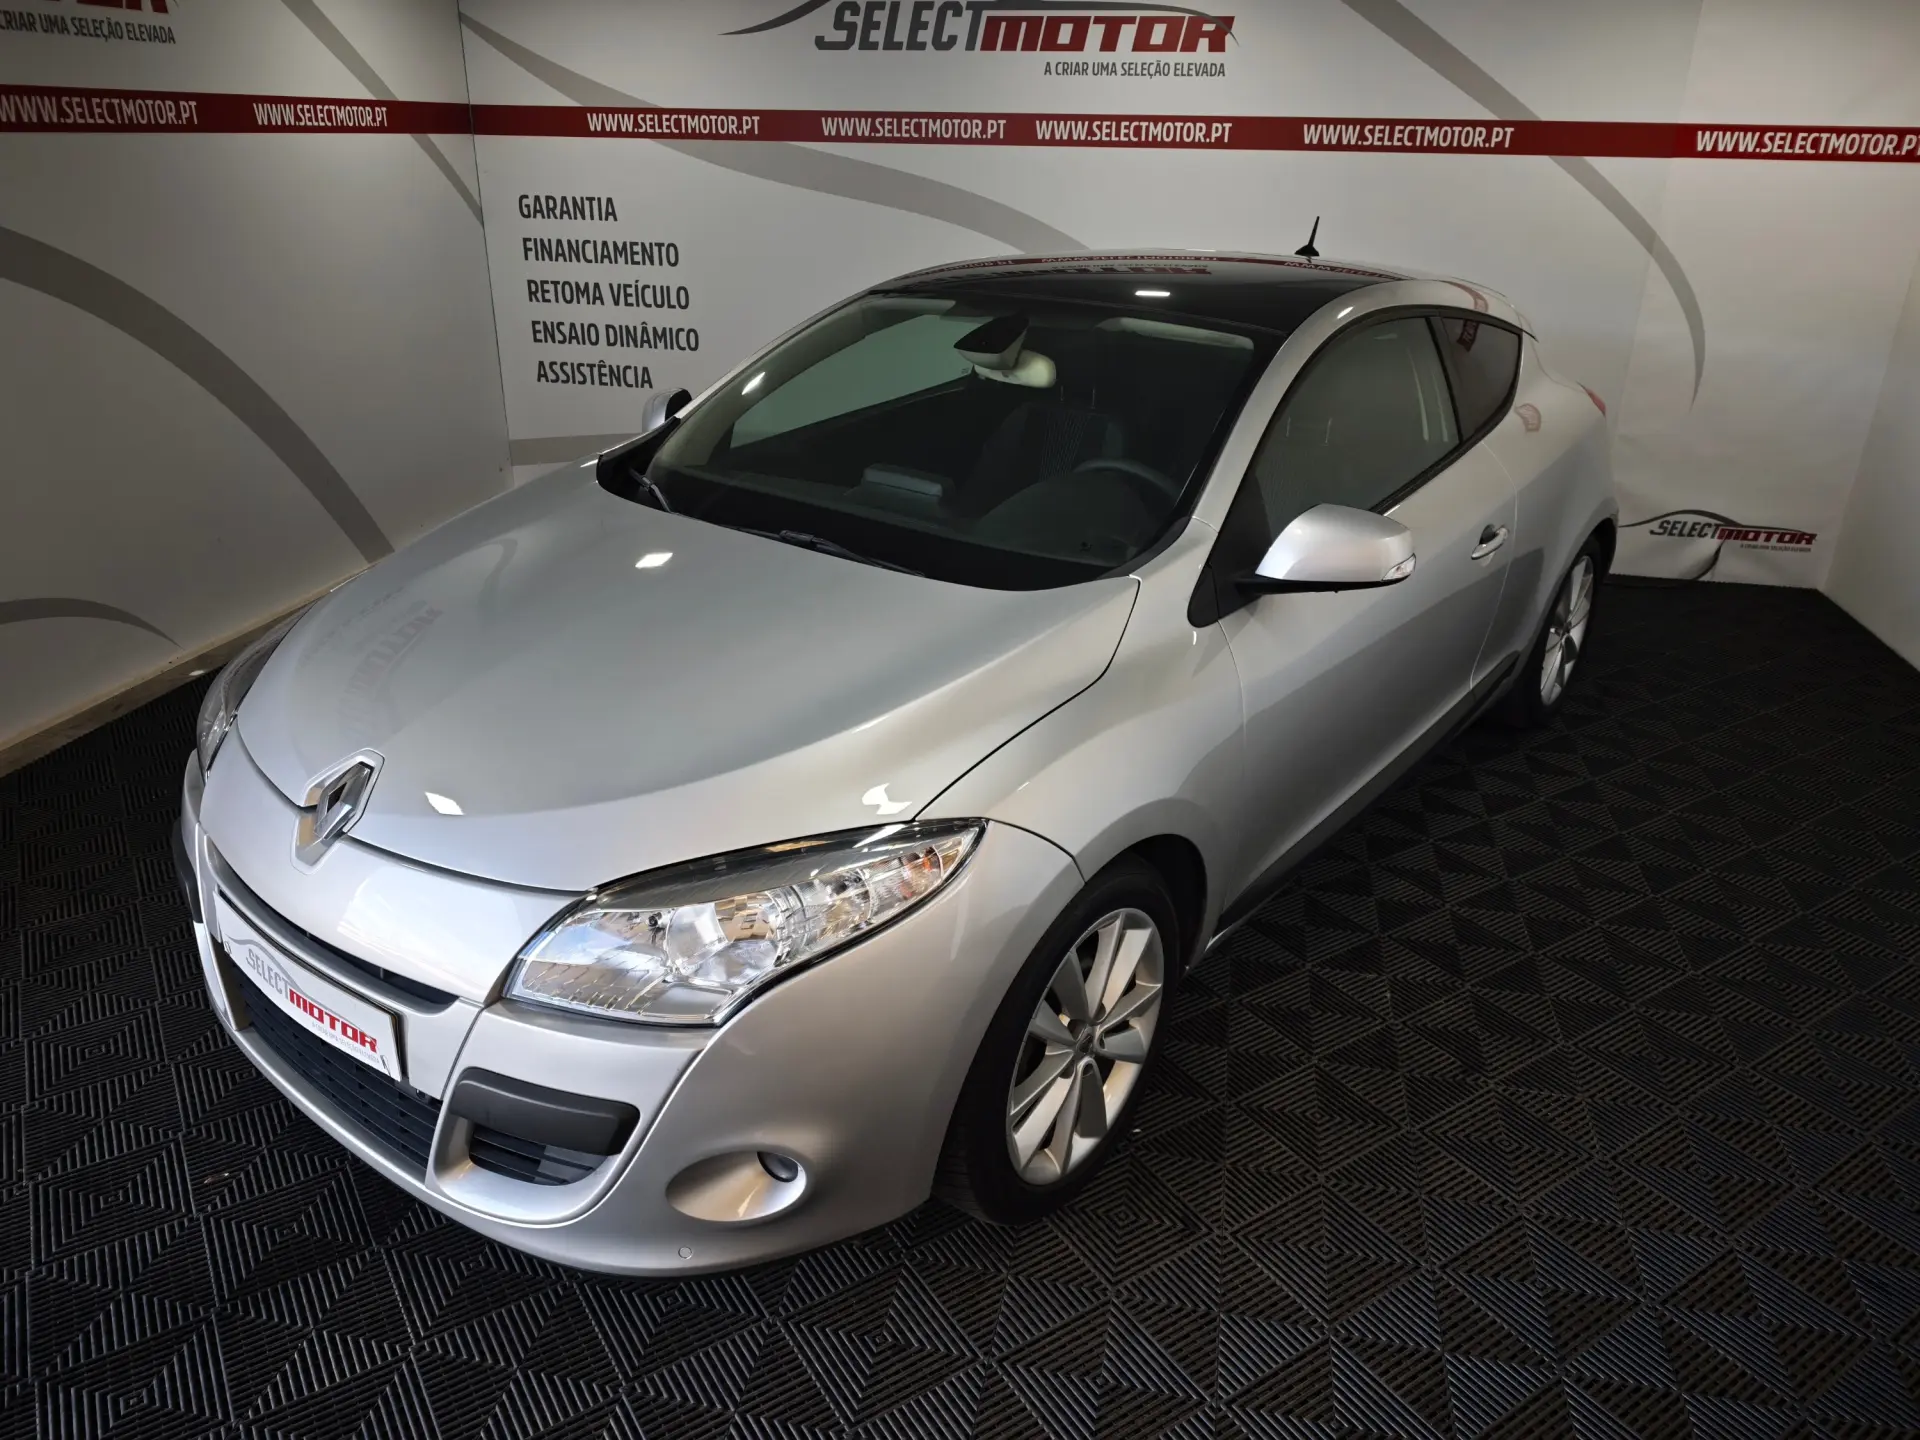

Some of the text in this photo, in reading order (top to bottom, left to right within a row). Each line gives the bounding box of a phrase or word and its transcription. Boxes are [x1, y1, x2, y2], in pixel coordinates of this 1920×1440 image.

[40, 14, 70, 37] UMA
[71, 17, 124, 42] SELEÇÃO
[126, 23, 176, 44] ELEVADA
[1044, 60, 1226, 80] A CRIAR UMA SELEÇÃO ELEVADA
[0, 95, 198, 126] WWW.SELECTMOTOR.PT
[253, 102, 387, 128] WWW.SELECTMOTOR.PT
[587, 112, 760, 136] WWW.SELECTMOTOR.PT
[822, 117, 1006, 139] WWW.SELECTMOTOR.PT
[1035, 120, 1232, 144] WWW.SELECTMOTOR.PT
[1303, 124, 1514, 149] WWW.SELECTMOTOR.PT
[518, 194, 618, 222] GARANTIA
[522, 237, 679, 267] FINANCIAMENTO
[527, 279, 689, 310] RETOMA VEÍCULO
[531, 320, 699, 352] ENSAIO DINÂMICO
[536, 360, 653, 389] ASSISTÊNCIA
